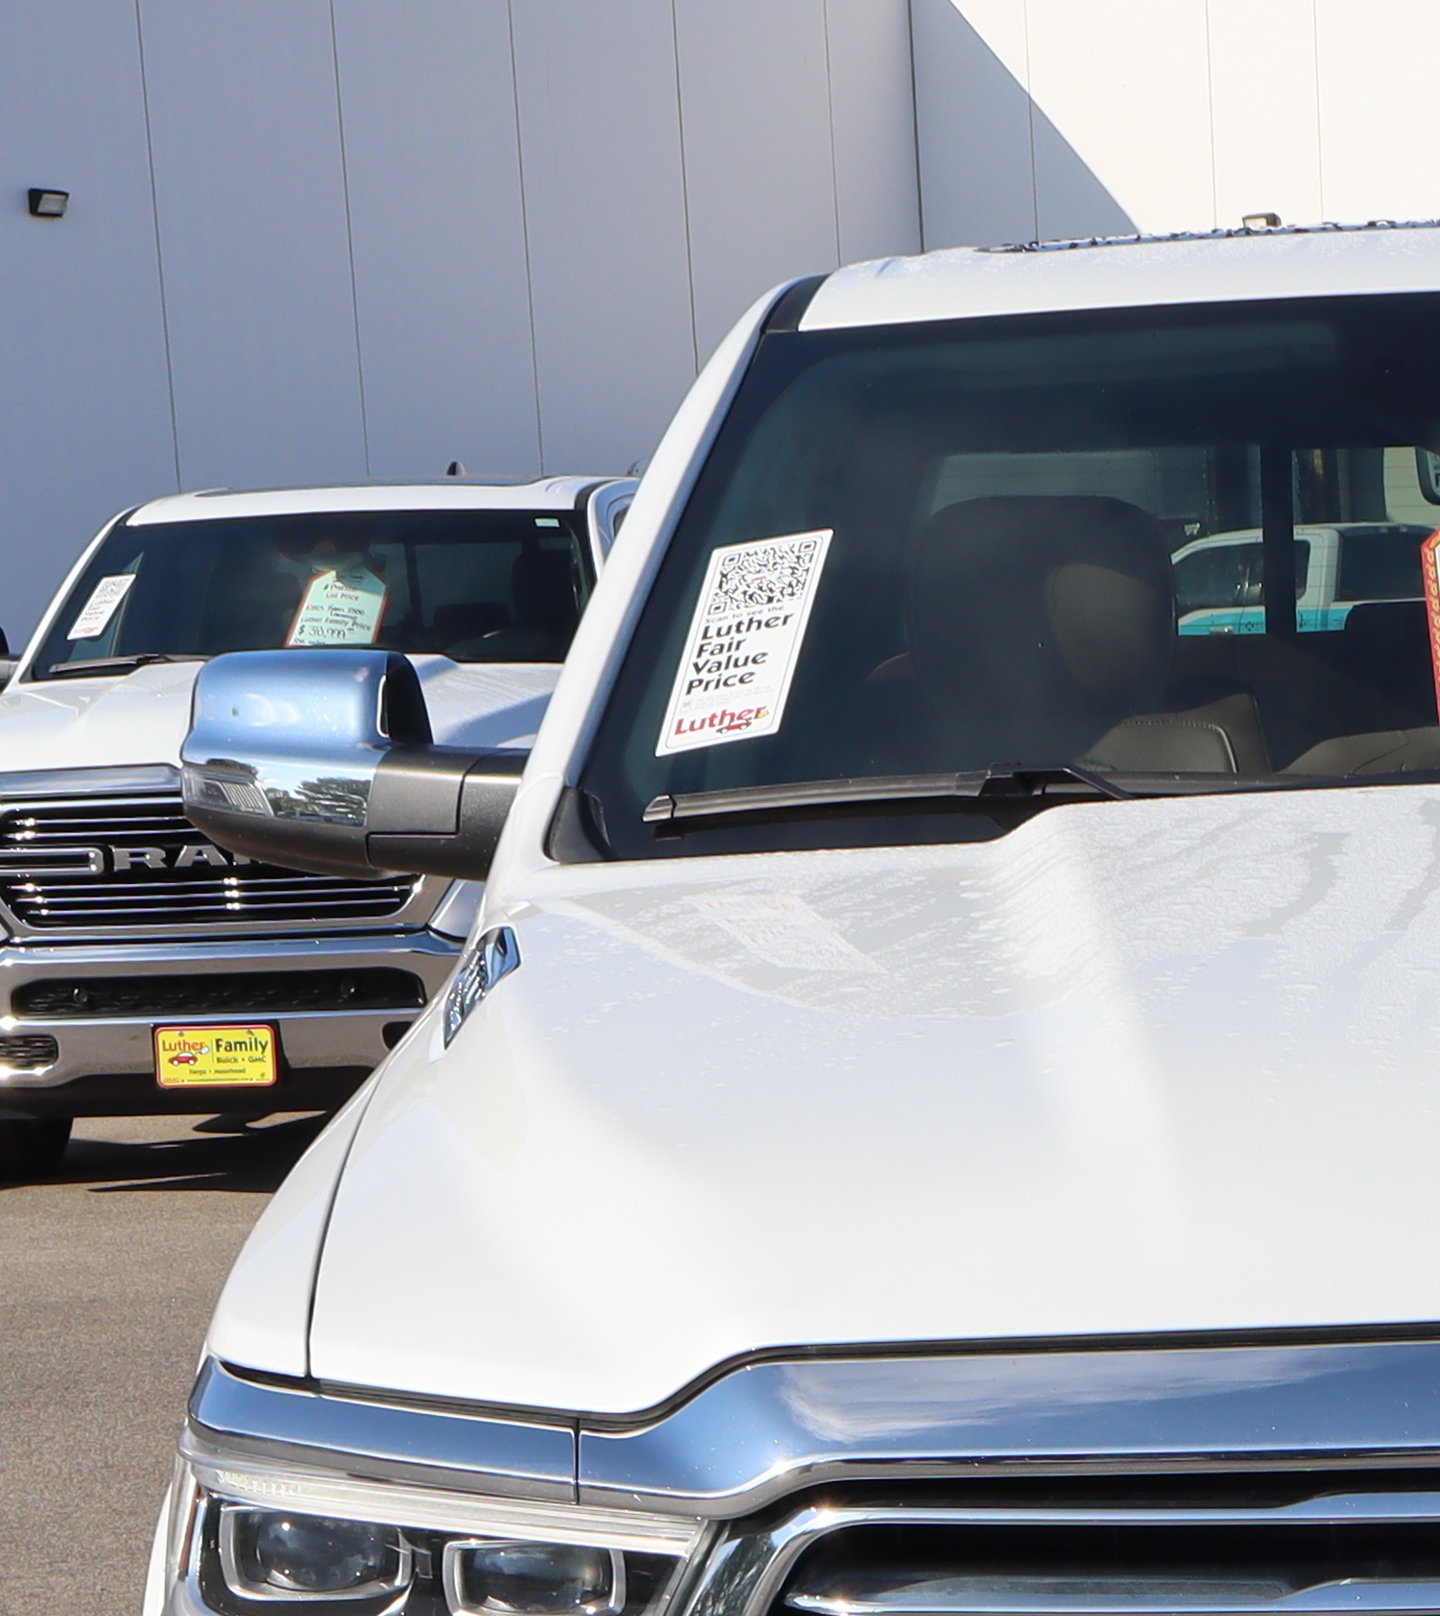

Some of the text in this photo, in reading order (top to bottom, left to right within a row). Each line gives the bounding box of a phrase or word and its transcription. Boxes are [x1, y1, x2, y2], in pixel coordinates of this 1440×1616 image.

[701, 613, 794, 641] Luther
[696, 637, 747, 659] Fair
[692, 652, 768, 675] Value
[686, 671, 756, 696] Price
[674, 705, 767, 736] Luther
[109, 844, 242, 872] RA
[162, 1037, 268, 1054] Luther Family
